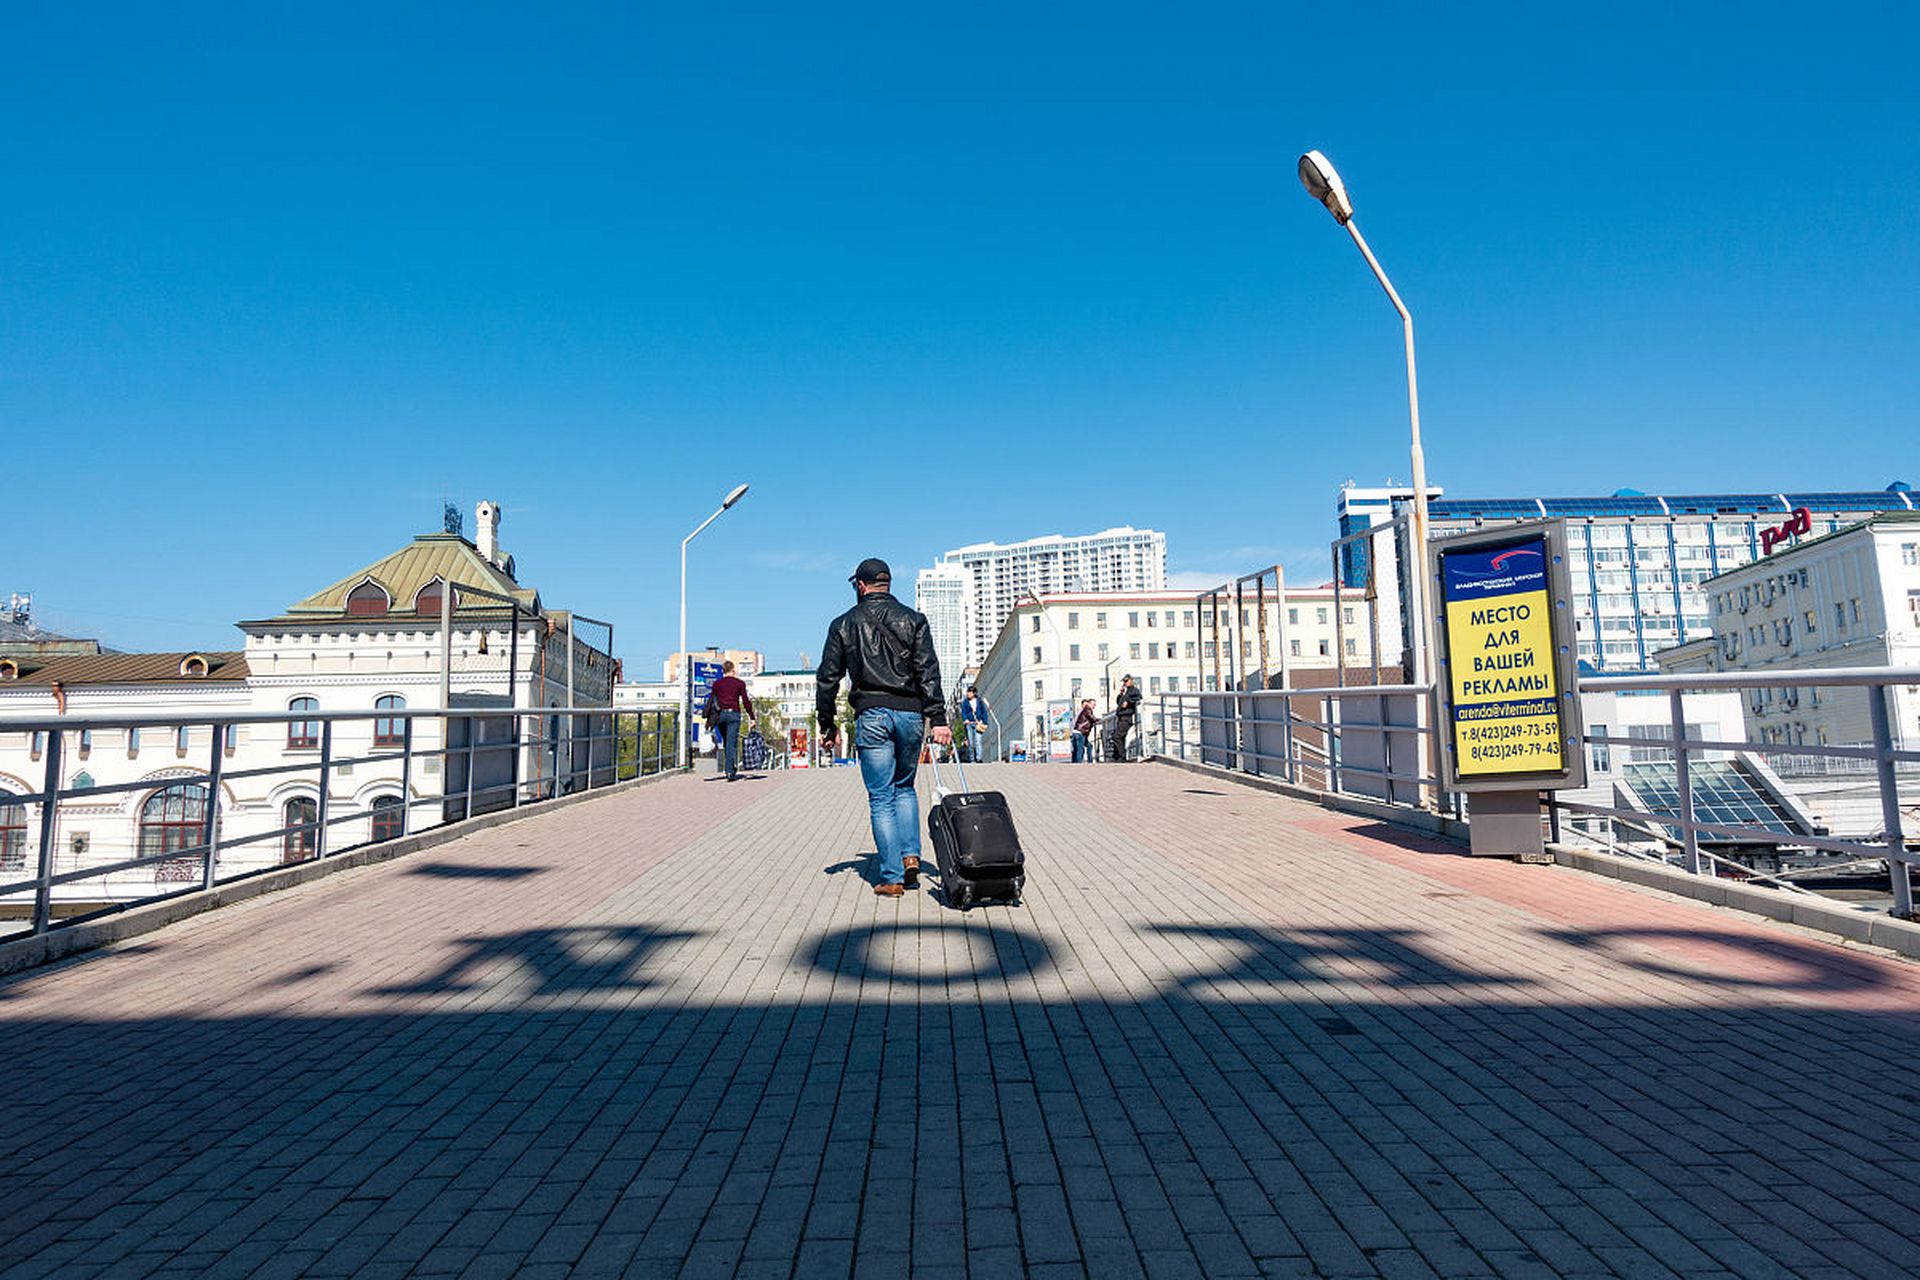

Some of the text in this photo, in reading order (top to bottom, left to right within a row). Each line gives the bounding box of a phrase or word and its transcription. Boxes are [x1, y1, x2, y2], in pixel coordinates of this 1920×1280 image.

[1471, 604, 1531, 626] МЕСТО
[1484, 629, 1520, 650] ДЛЯ
[1473, 648, 1534, 672] ВАШЕЙ
[1463, 674, 1548, 696] РЕКЛАМЫ
[1471, 741, 1560, 762] 8(423)249-79-43
